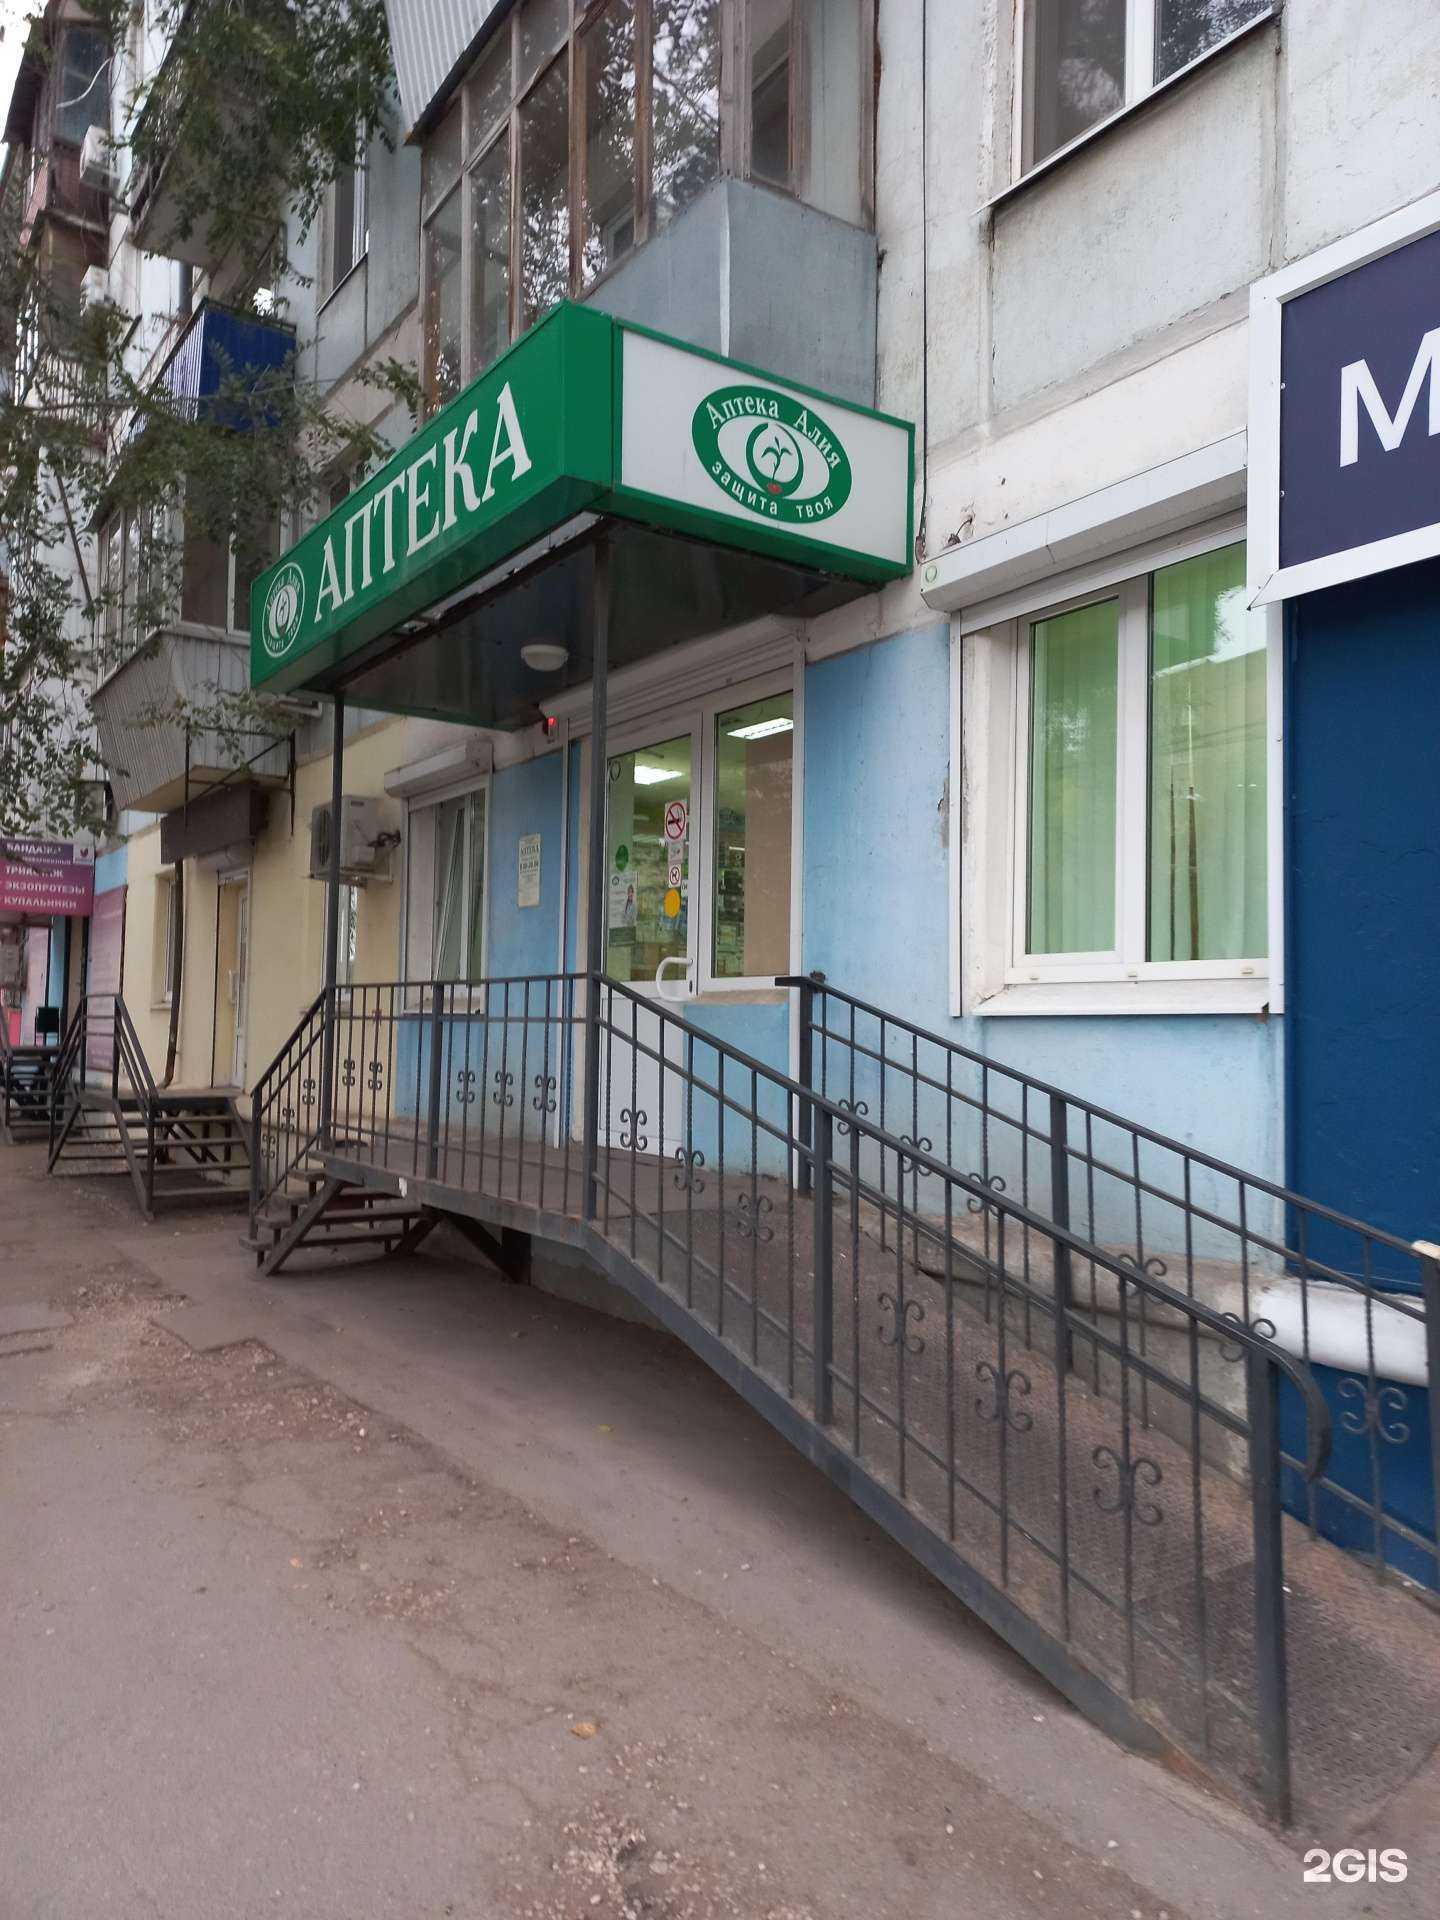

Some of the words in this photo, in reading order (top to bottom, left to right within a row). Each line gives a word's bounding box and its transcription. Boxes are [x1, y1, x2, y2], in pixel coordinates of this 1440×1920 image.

[706, 396, 780, 430] Аптека
[793, 409, 841, 469] Алия
[314, 381, 532, 623] АПТЕКА
[712, 461, 778, 516] защита
[796, 496, 834, 519] твоя
[4, 896, 76, 909] КУПАЛЬНИКИ
